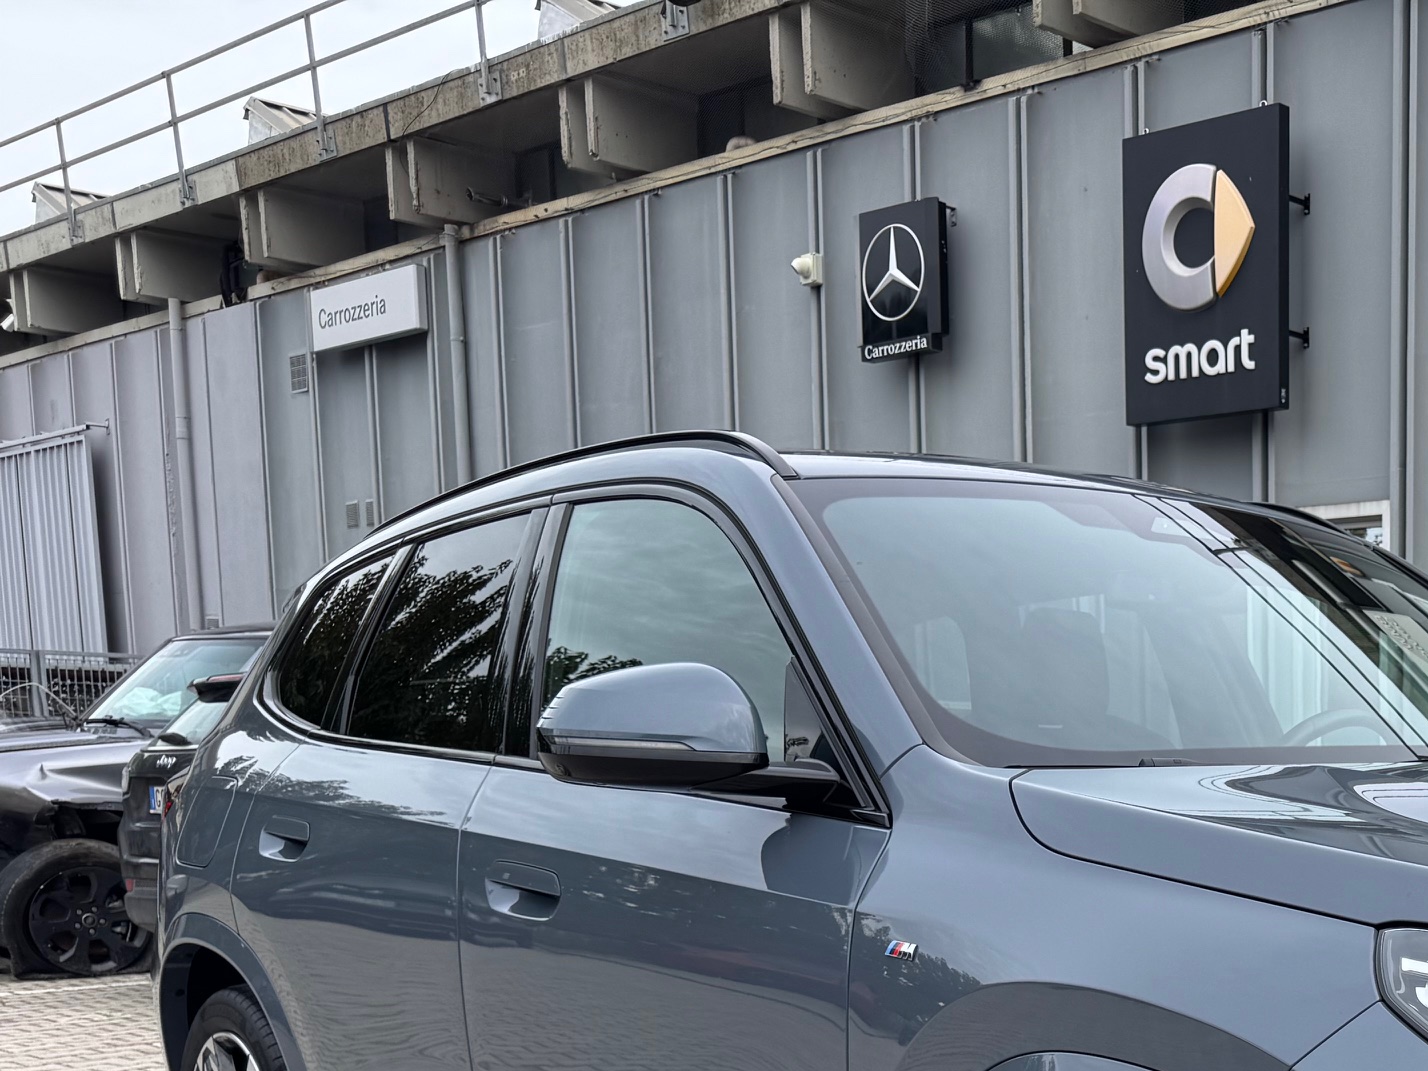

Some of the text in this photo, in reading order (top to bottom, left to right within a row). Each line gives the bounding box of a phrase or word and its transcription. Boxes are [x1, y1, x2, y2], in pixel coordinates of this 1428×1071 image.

[318, 294, 386, 329] Carrozzeria
[864, 335, 928, 359] Carrozzeria
[1144, 328, 1256, 384] smart
